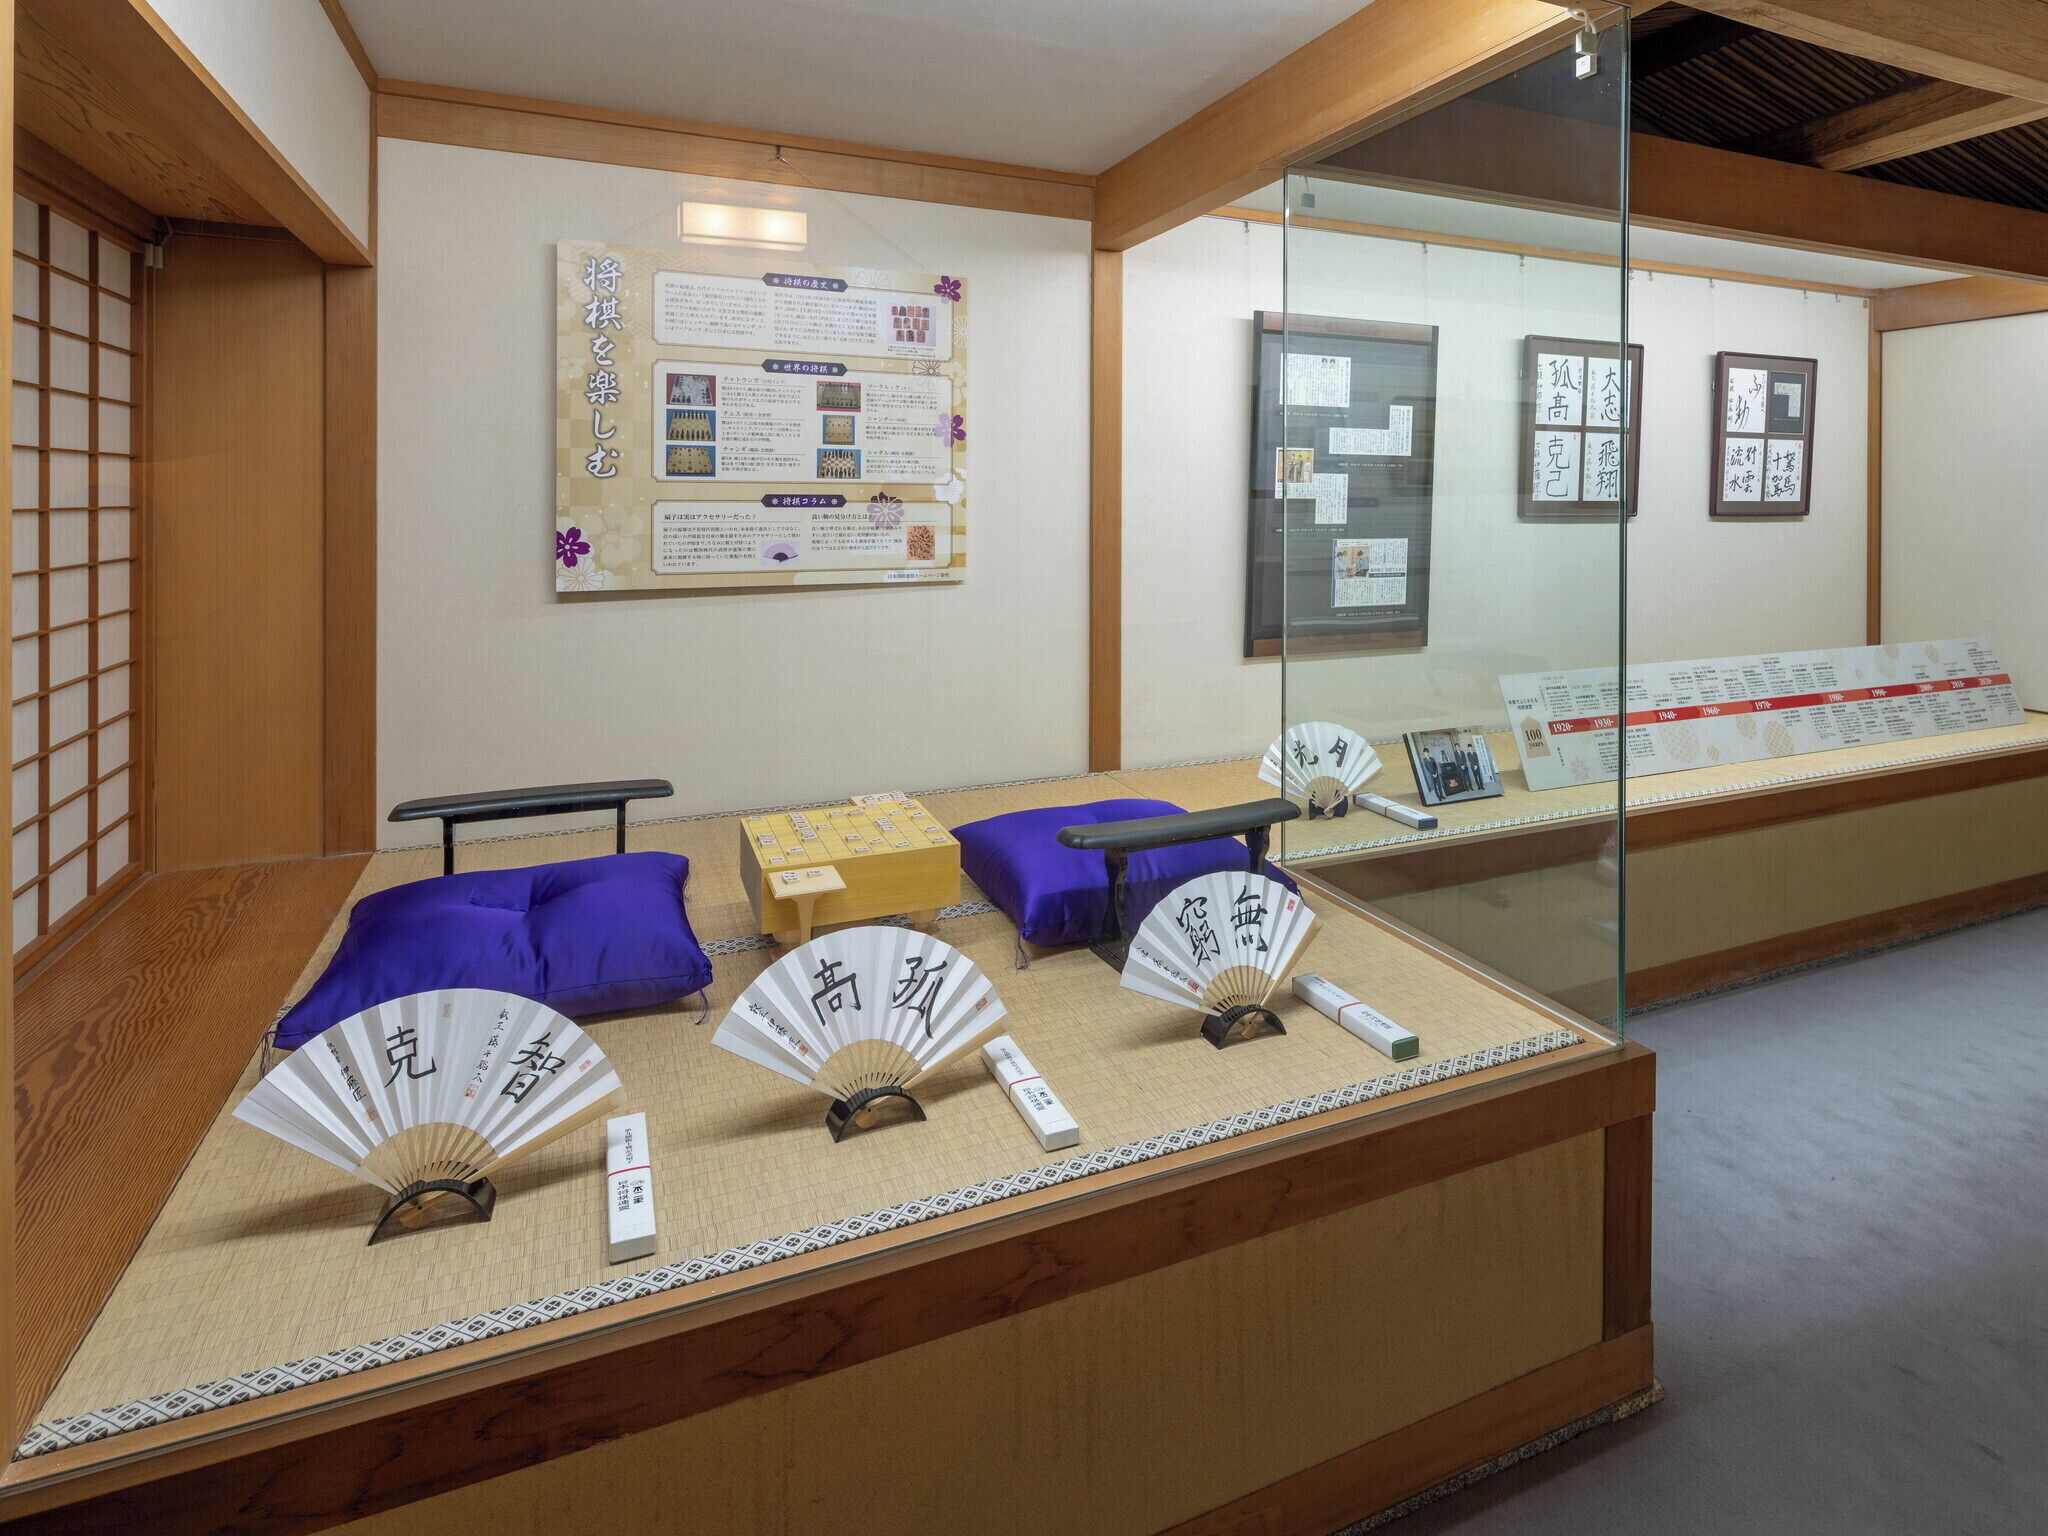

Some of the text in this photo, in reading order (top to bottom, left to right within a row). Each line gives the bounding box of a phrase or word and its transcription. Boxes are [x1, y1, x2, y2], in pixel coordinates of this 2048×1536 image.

[783, 276, 828, 290] 将棋の歴史
[584, 257, 623, 479] 将棋を楽しむ
[783, 363, 829, 374] 世界の将棋
[1547, 358, 1578, 421] 孤高
[1601, 366, 1622, 422] 大志
[1546, 435, 1570, 497] 克己
[1596, 439, 1620, 498] 飛翔
[1729, 446, 1744, 492] 流水
[783, 495, 827, 506] 将棋コラム
[1658, 711, 1677, 720] 1940-
[1754, 701, 1772, 710] 1970-
[1525, 728, 1542, 741] 100
[1552, 722, 1573, 733] 1920-
[1594, 718, 1614, 728] 1930-
[1528, 741, 1544, 751] years
[384, 1025, 437, 1088] 克
[499, 1031, 567, 1104] 智
[616, 1180, 630, 1213] 日本将棋連盟
